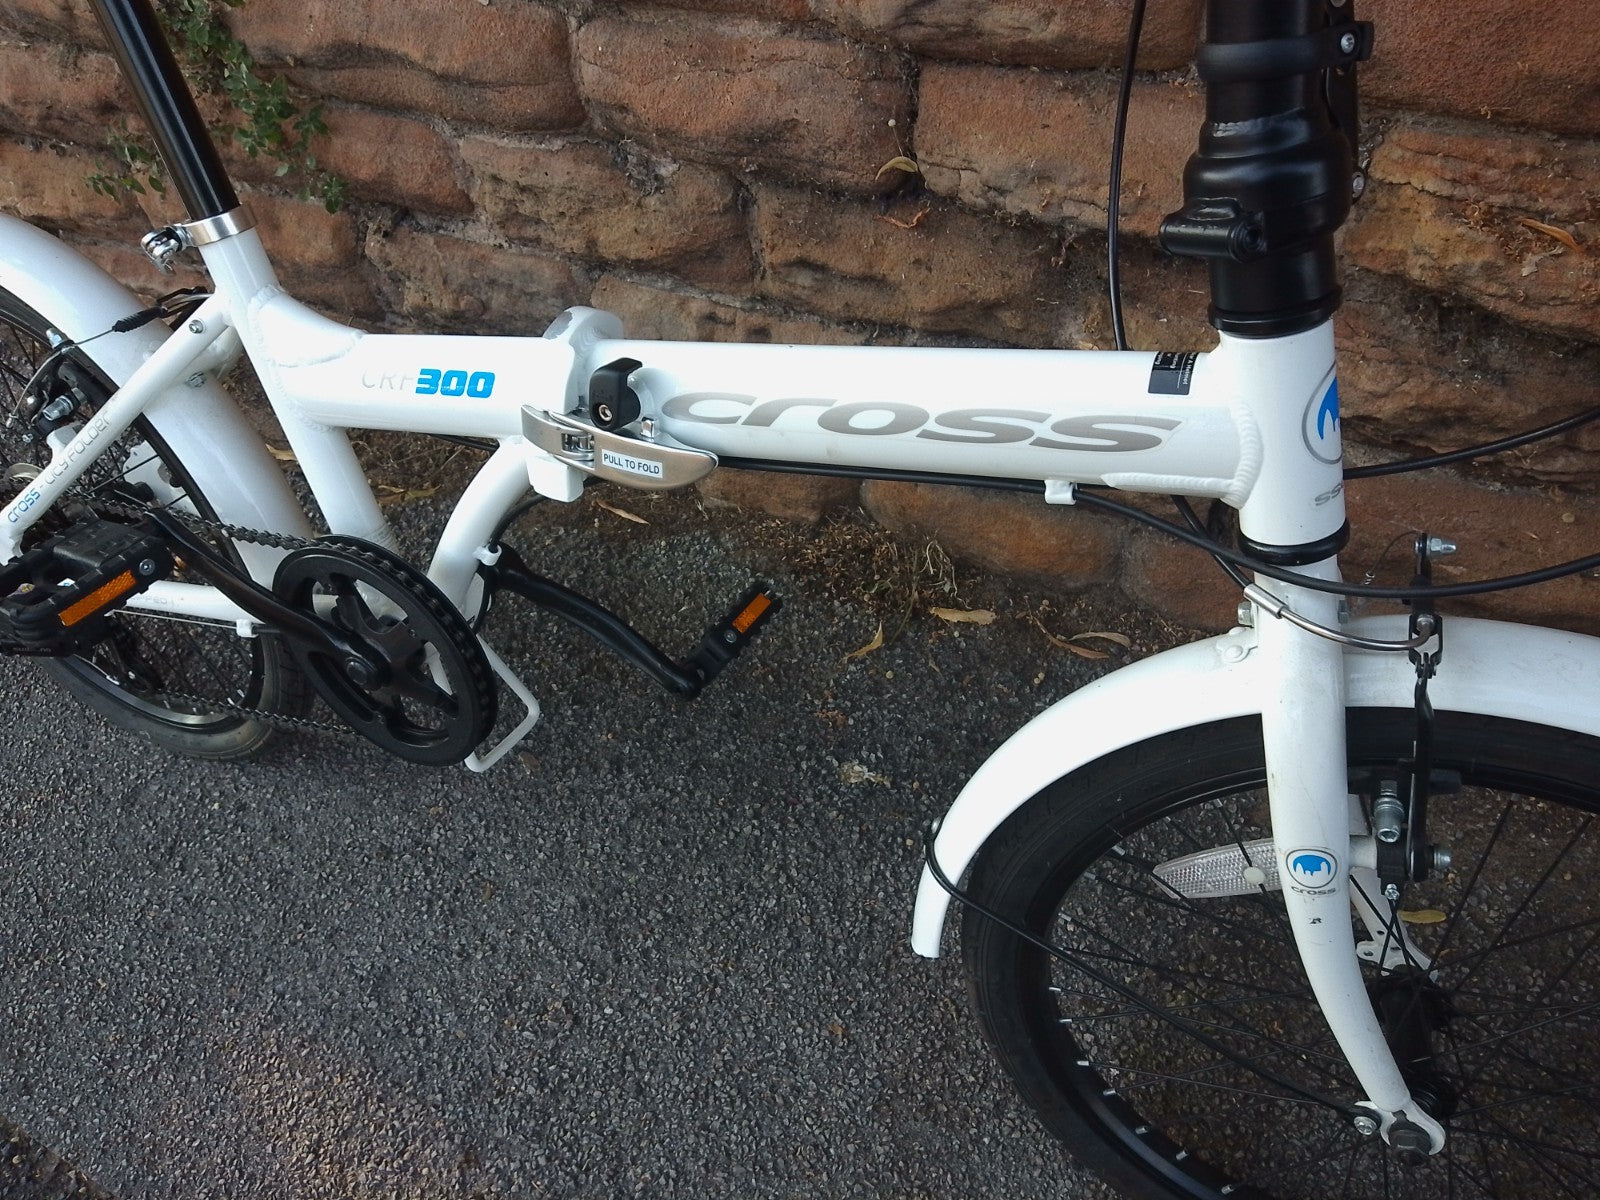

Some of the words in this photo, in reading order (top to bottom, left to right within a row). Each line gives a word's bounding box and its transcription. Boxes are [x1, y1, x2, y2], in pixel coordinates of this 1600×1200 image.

[661, 391, 1183, 453] cross
[603, 453, 623, 467] PULL
[624, 459, 636, 470] TO
[637, 462, 660, 474] FOLD
[1291, 886, 1337, 896] cross
